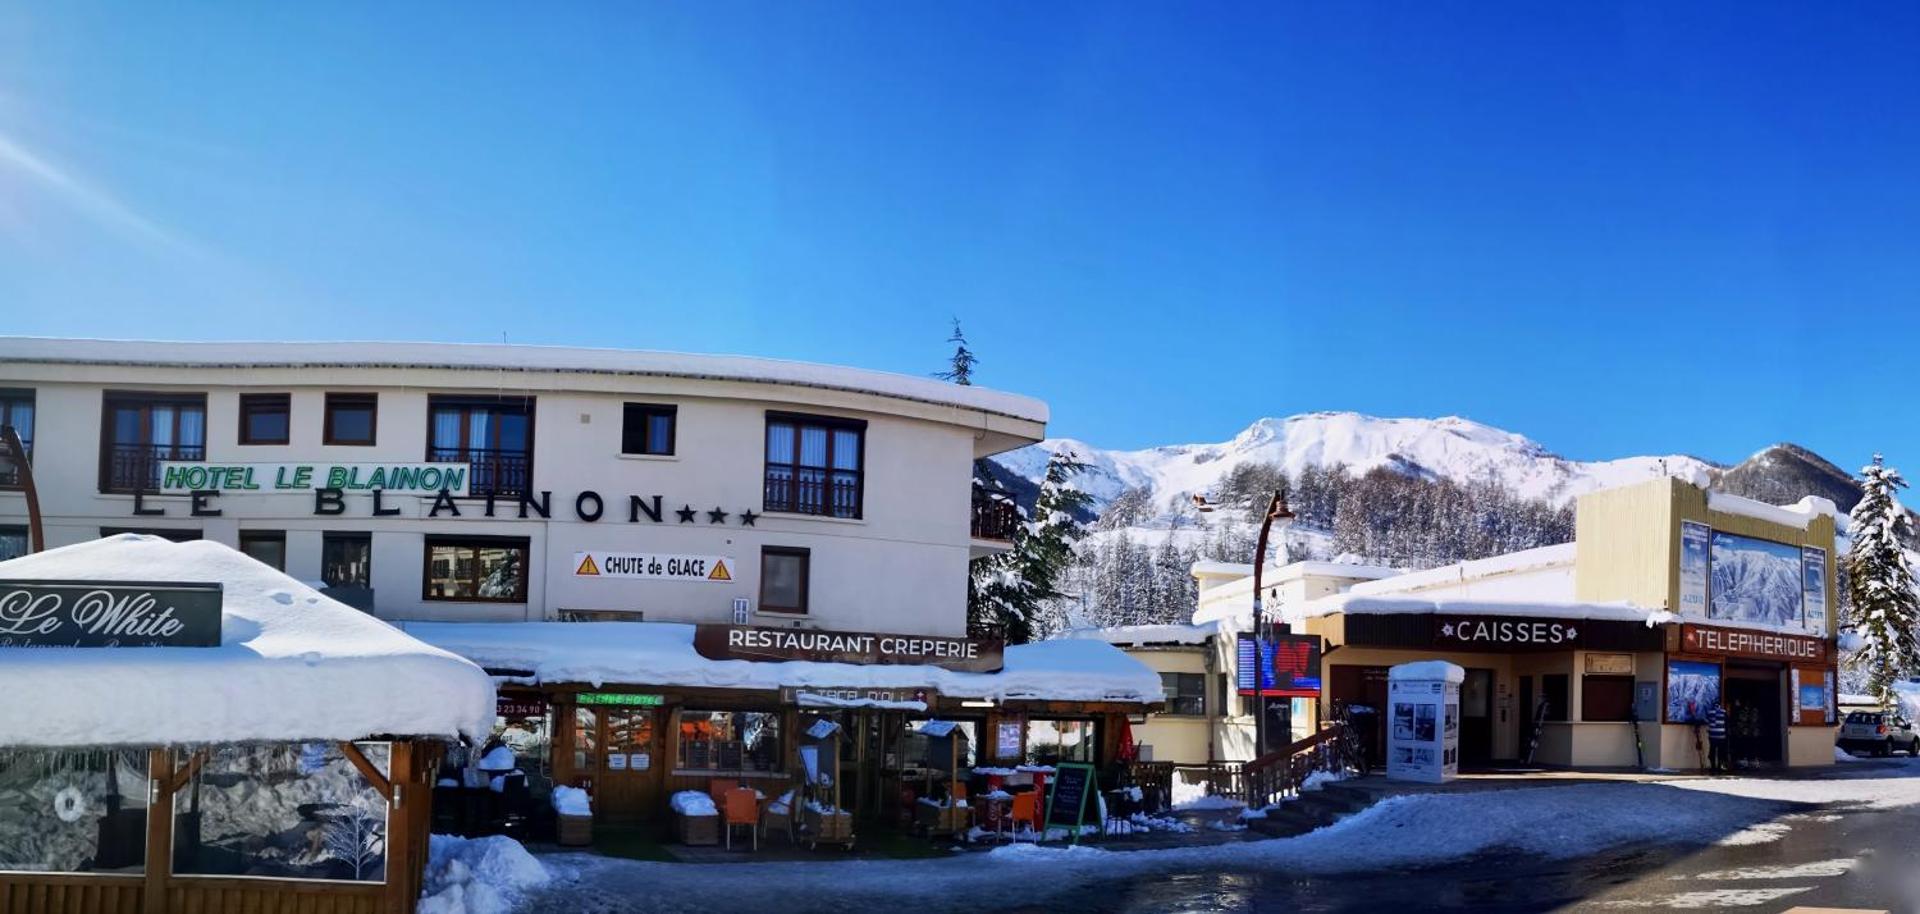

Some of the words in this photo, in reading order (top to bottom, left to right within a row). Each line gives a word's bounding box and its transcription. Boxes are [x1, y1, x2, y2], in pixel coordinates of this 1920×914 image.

[163, 466, 260, 489] HOTEL
[275, 466, 313, 489] LE
[326, 466, 465, 491] BLAINON
[133, 487, 222, 517] LE
[313, 487, 664, 523] BLAINON
[604, 555, 643, 574] CHUTE
[647, 556, 662, 575] de
[667, 558, 705, 577] GLACE
[0, 589, 62, 635] Le
[71, 589, 185, 637] White
[728, 629, 875, 654] RESTAURANT
[879, 638, 979, 659] CREPERIE
[1456, 621, 1563, 644] CAISSES
[503, 704, 515, 713] 23
